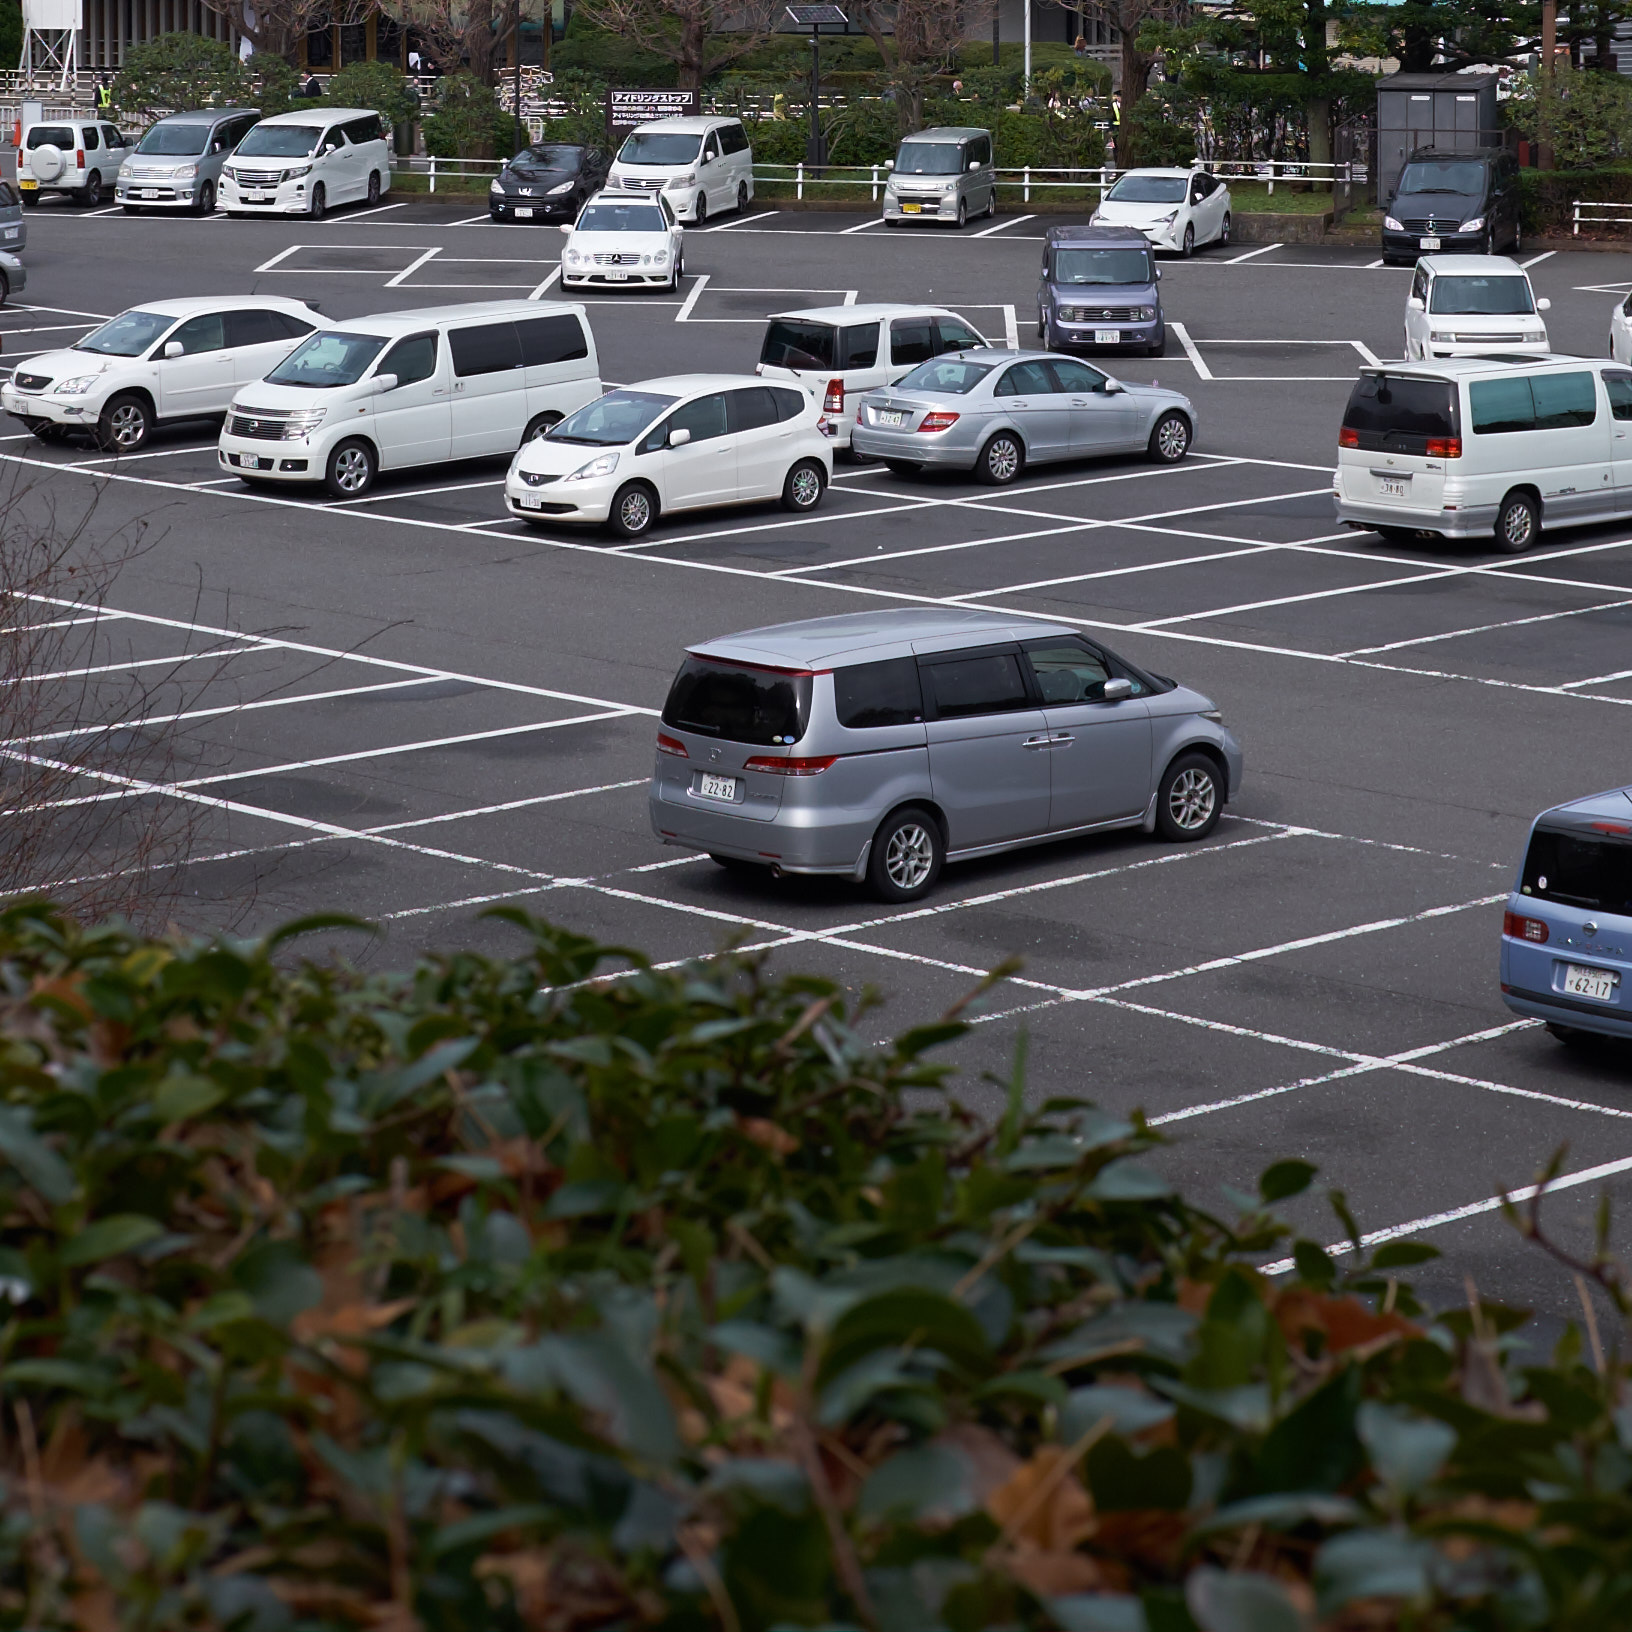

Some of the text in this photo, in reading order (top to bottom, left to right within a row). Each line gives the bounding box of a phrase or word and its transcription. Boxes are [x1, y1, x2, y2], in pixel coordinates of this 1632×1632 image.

[614, 94, 690, 103] アイドリングストップ
[708, 781, 733, 798] 22-82
[1575, 976, 1609, 997] 62-17
